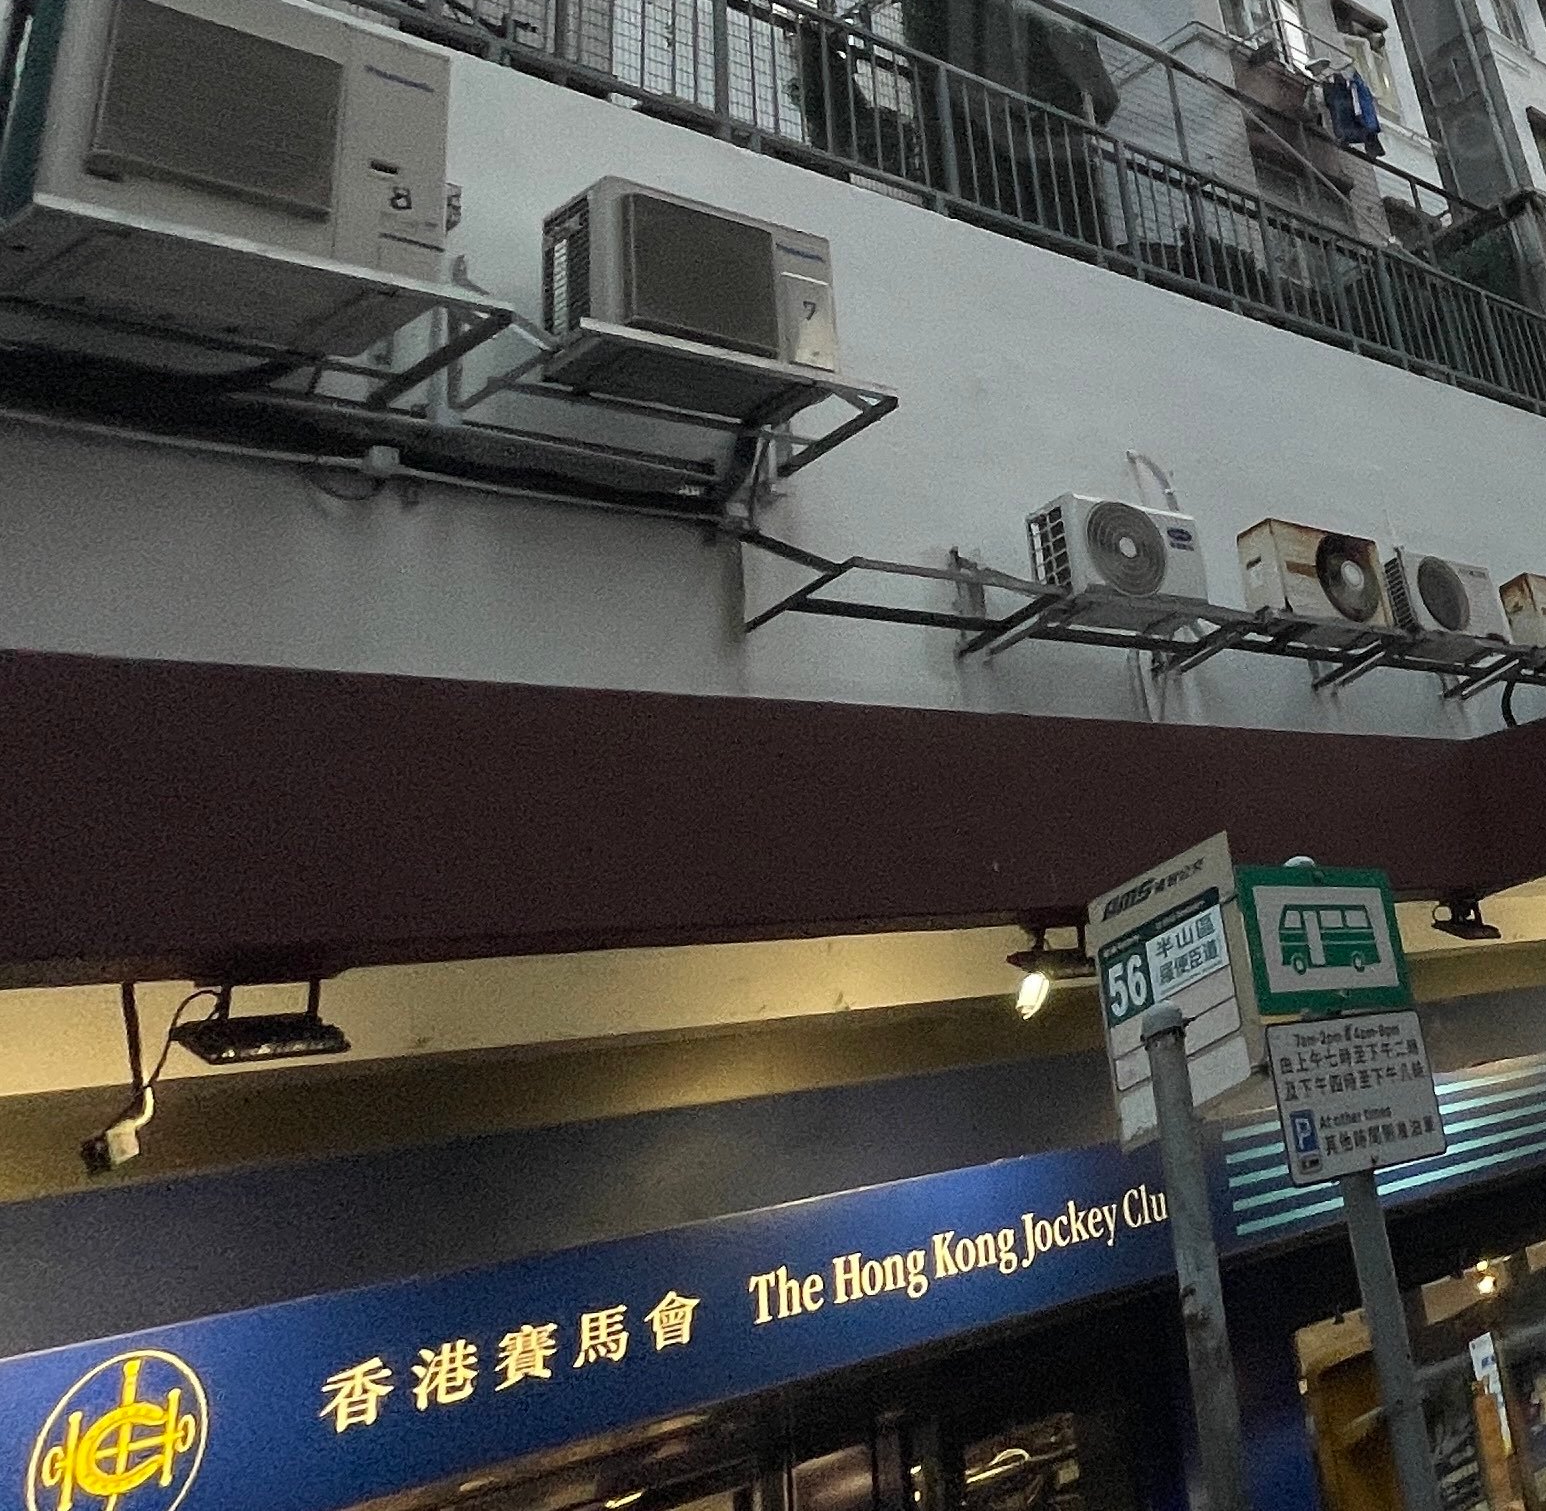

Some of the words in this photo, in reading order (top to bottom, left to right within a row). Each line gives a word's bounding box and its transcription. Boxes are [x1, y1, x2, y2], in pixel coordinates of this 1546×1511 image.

[1108, 954, 1148, 1017] 56
[748, 1265, 825, 1326] The
[832, 1246, 929, 1299] Hong
[932, 1228, 1016, 1275] Kong
[1020, 1200, 1117, 1269] Jockey
[1122, 1183, 1169, 1229] Clu
[318, 1290, 701, 1434] 香港賽馬會
